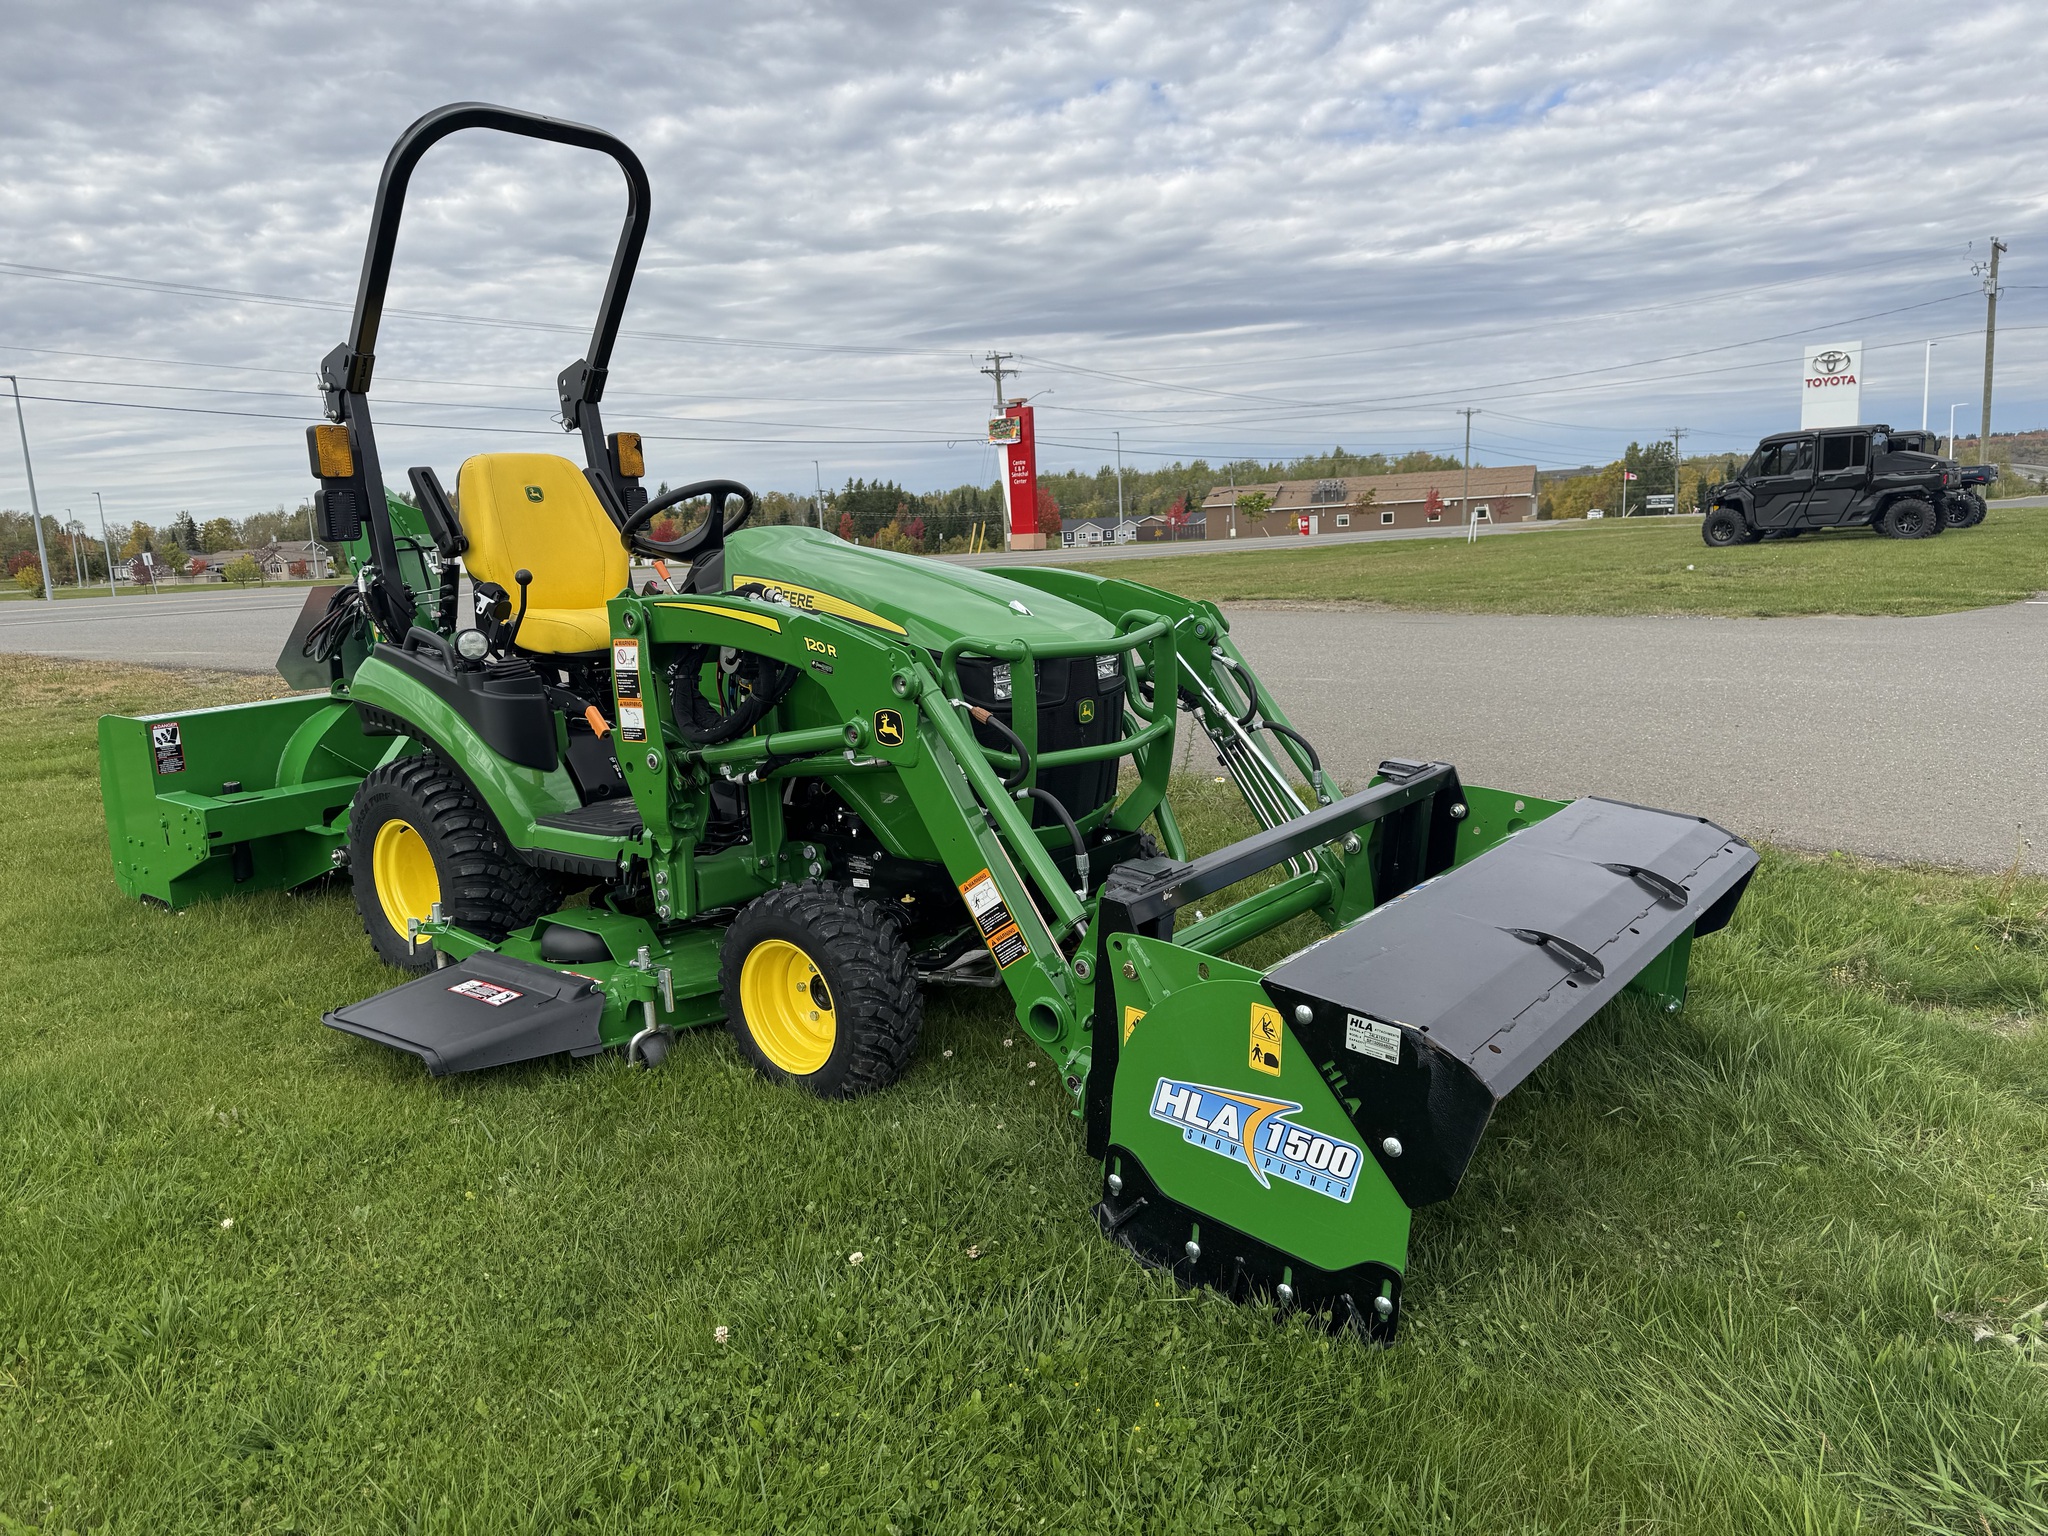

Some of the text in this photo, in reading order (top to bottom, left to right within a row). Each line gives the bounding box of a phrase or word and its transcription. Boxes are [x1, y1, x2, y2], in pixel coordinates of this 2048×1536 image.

[1805, 375, 1856, 388] TOYOTA
[967, 872, 987, 888] WARNING
[995, 927, 1016, 942] WARNING
[1350, 1017, 1373, 1031] HLA
[1322, 1060, 1362, 1116] HLA
[1155, 1081, 1358, 1180] HLA 1500
[1187, 1128, 1348, 1199] SNOW PUSHER
